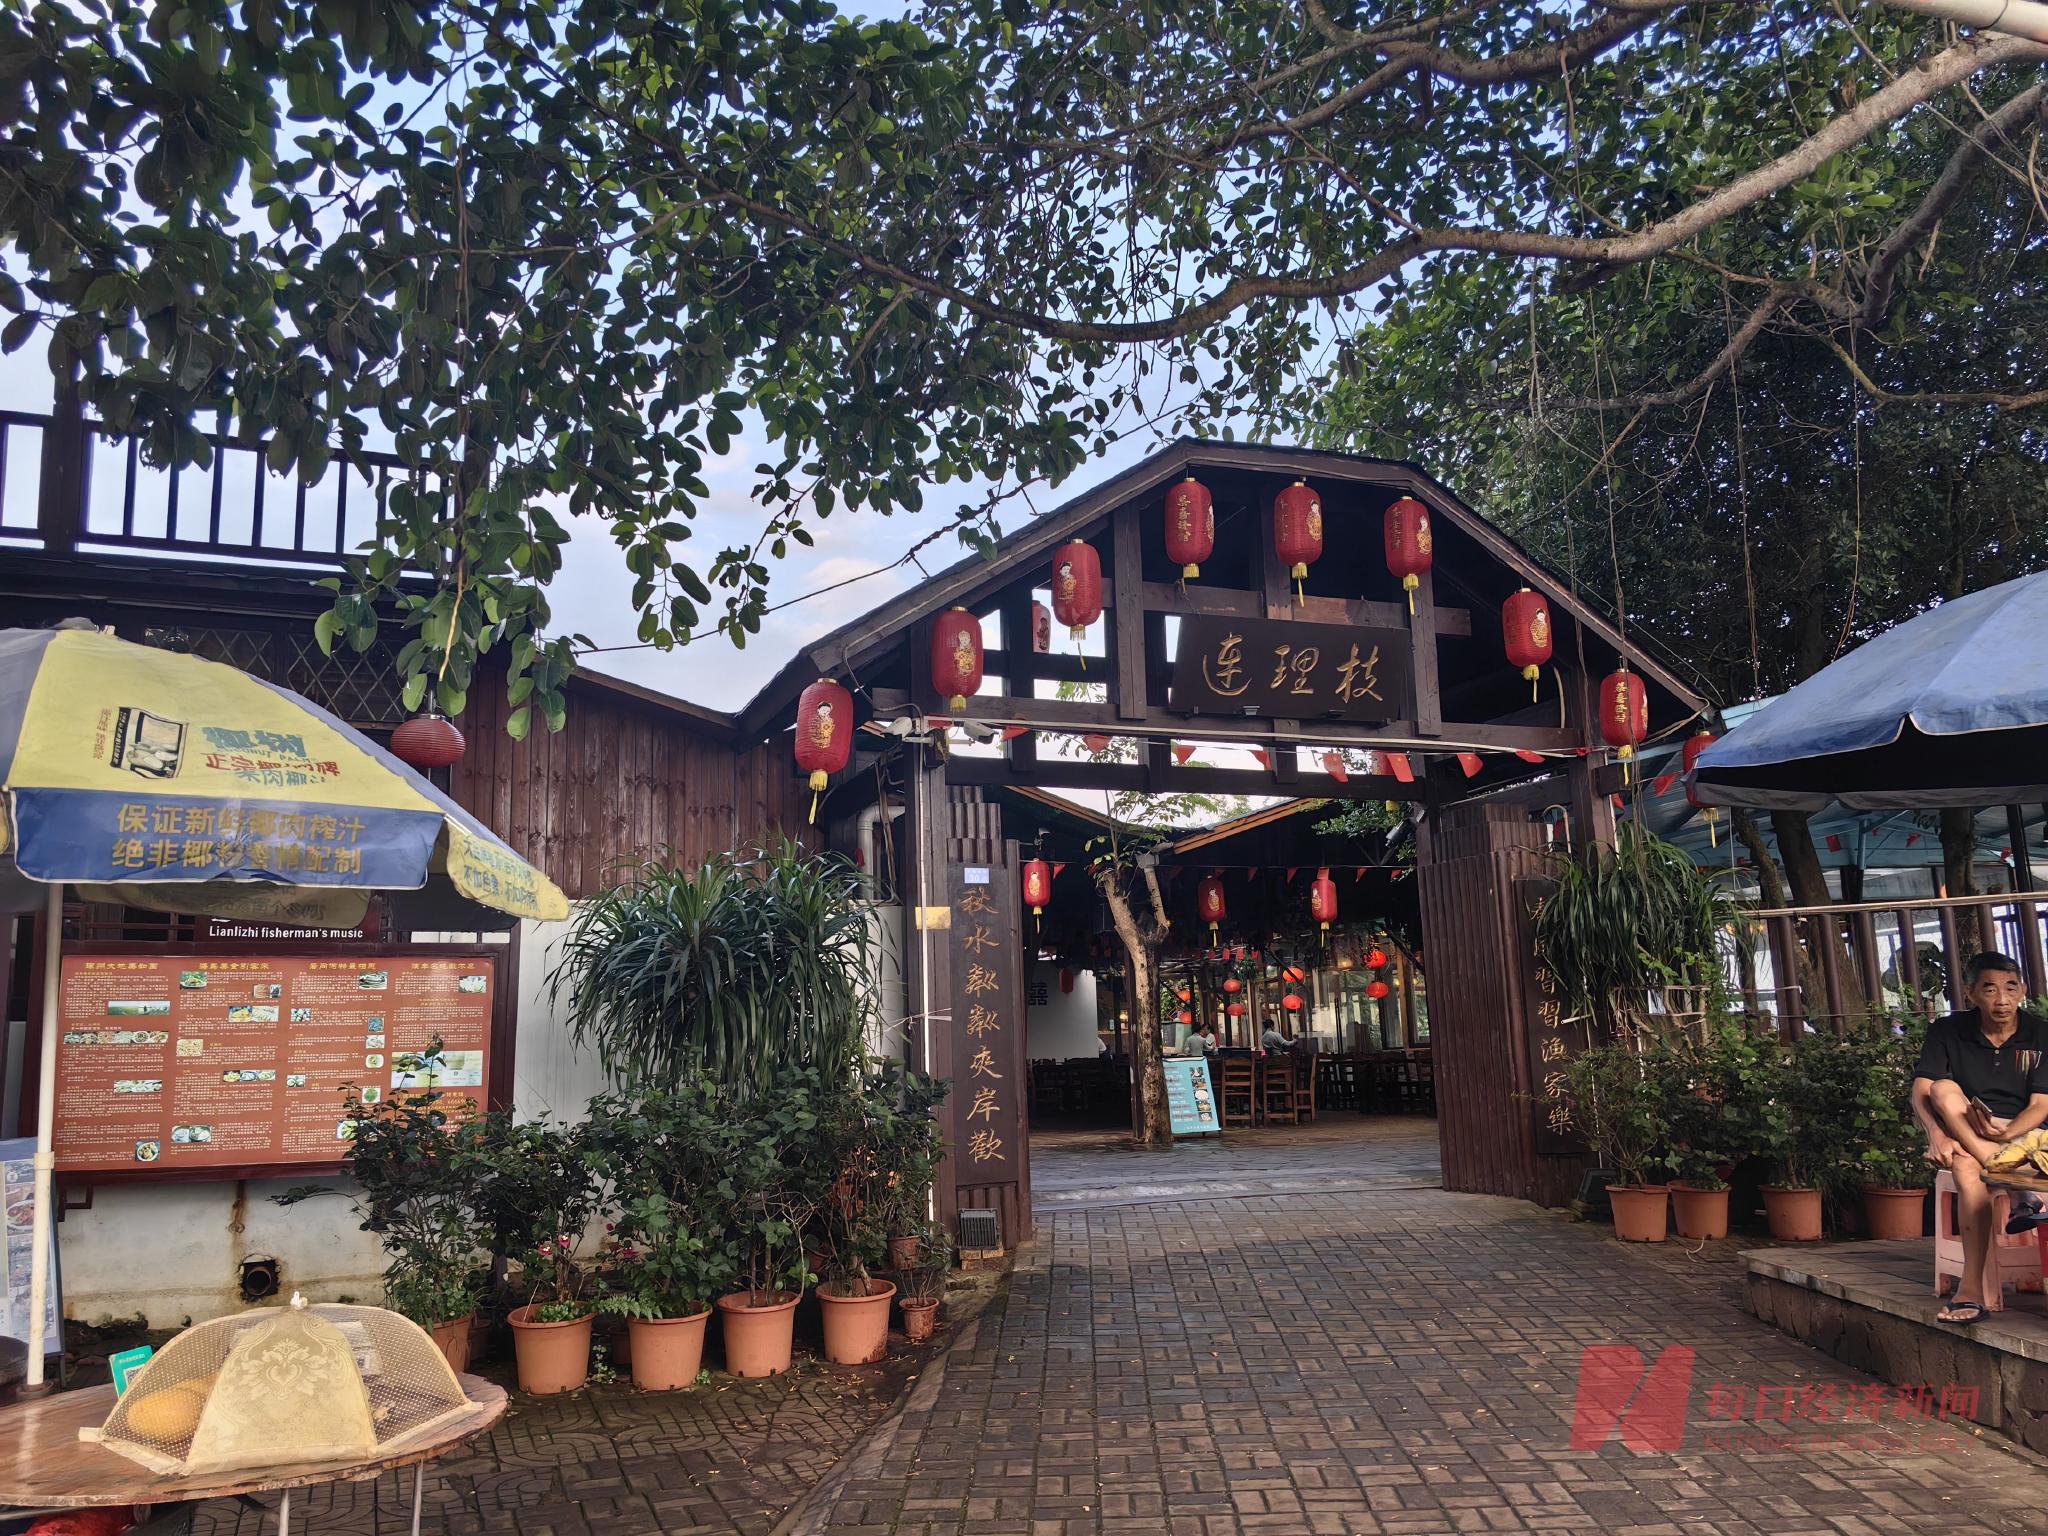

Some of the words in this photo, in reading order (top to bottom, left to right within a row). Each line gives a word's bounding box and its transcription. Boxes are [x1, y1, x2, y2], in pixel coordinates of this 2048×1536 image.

[209, 925, 259, 938] Lianlizhi
[261, 927, 328, 939] fisherman's
[330, 929, 364, 939] music
